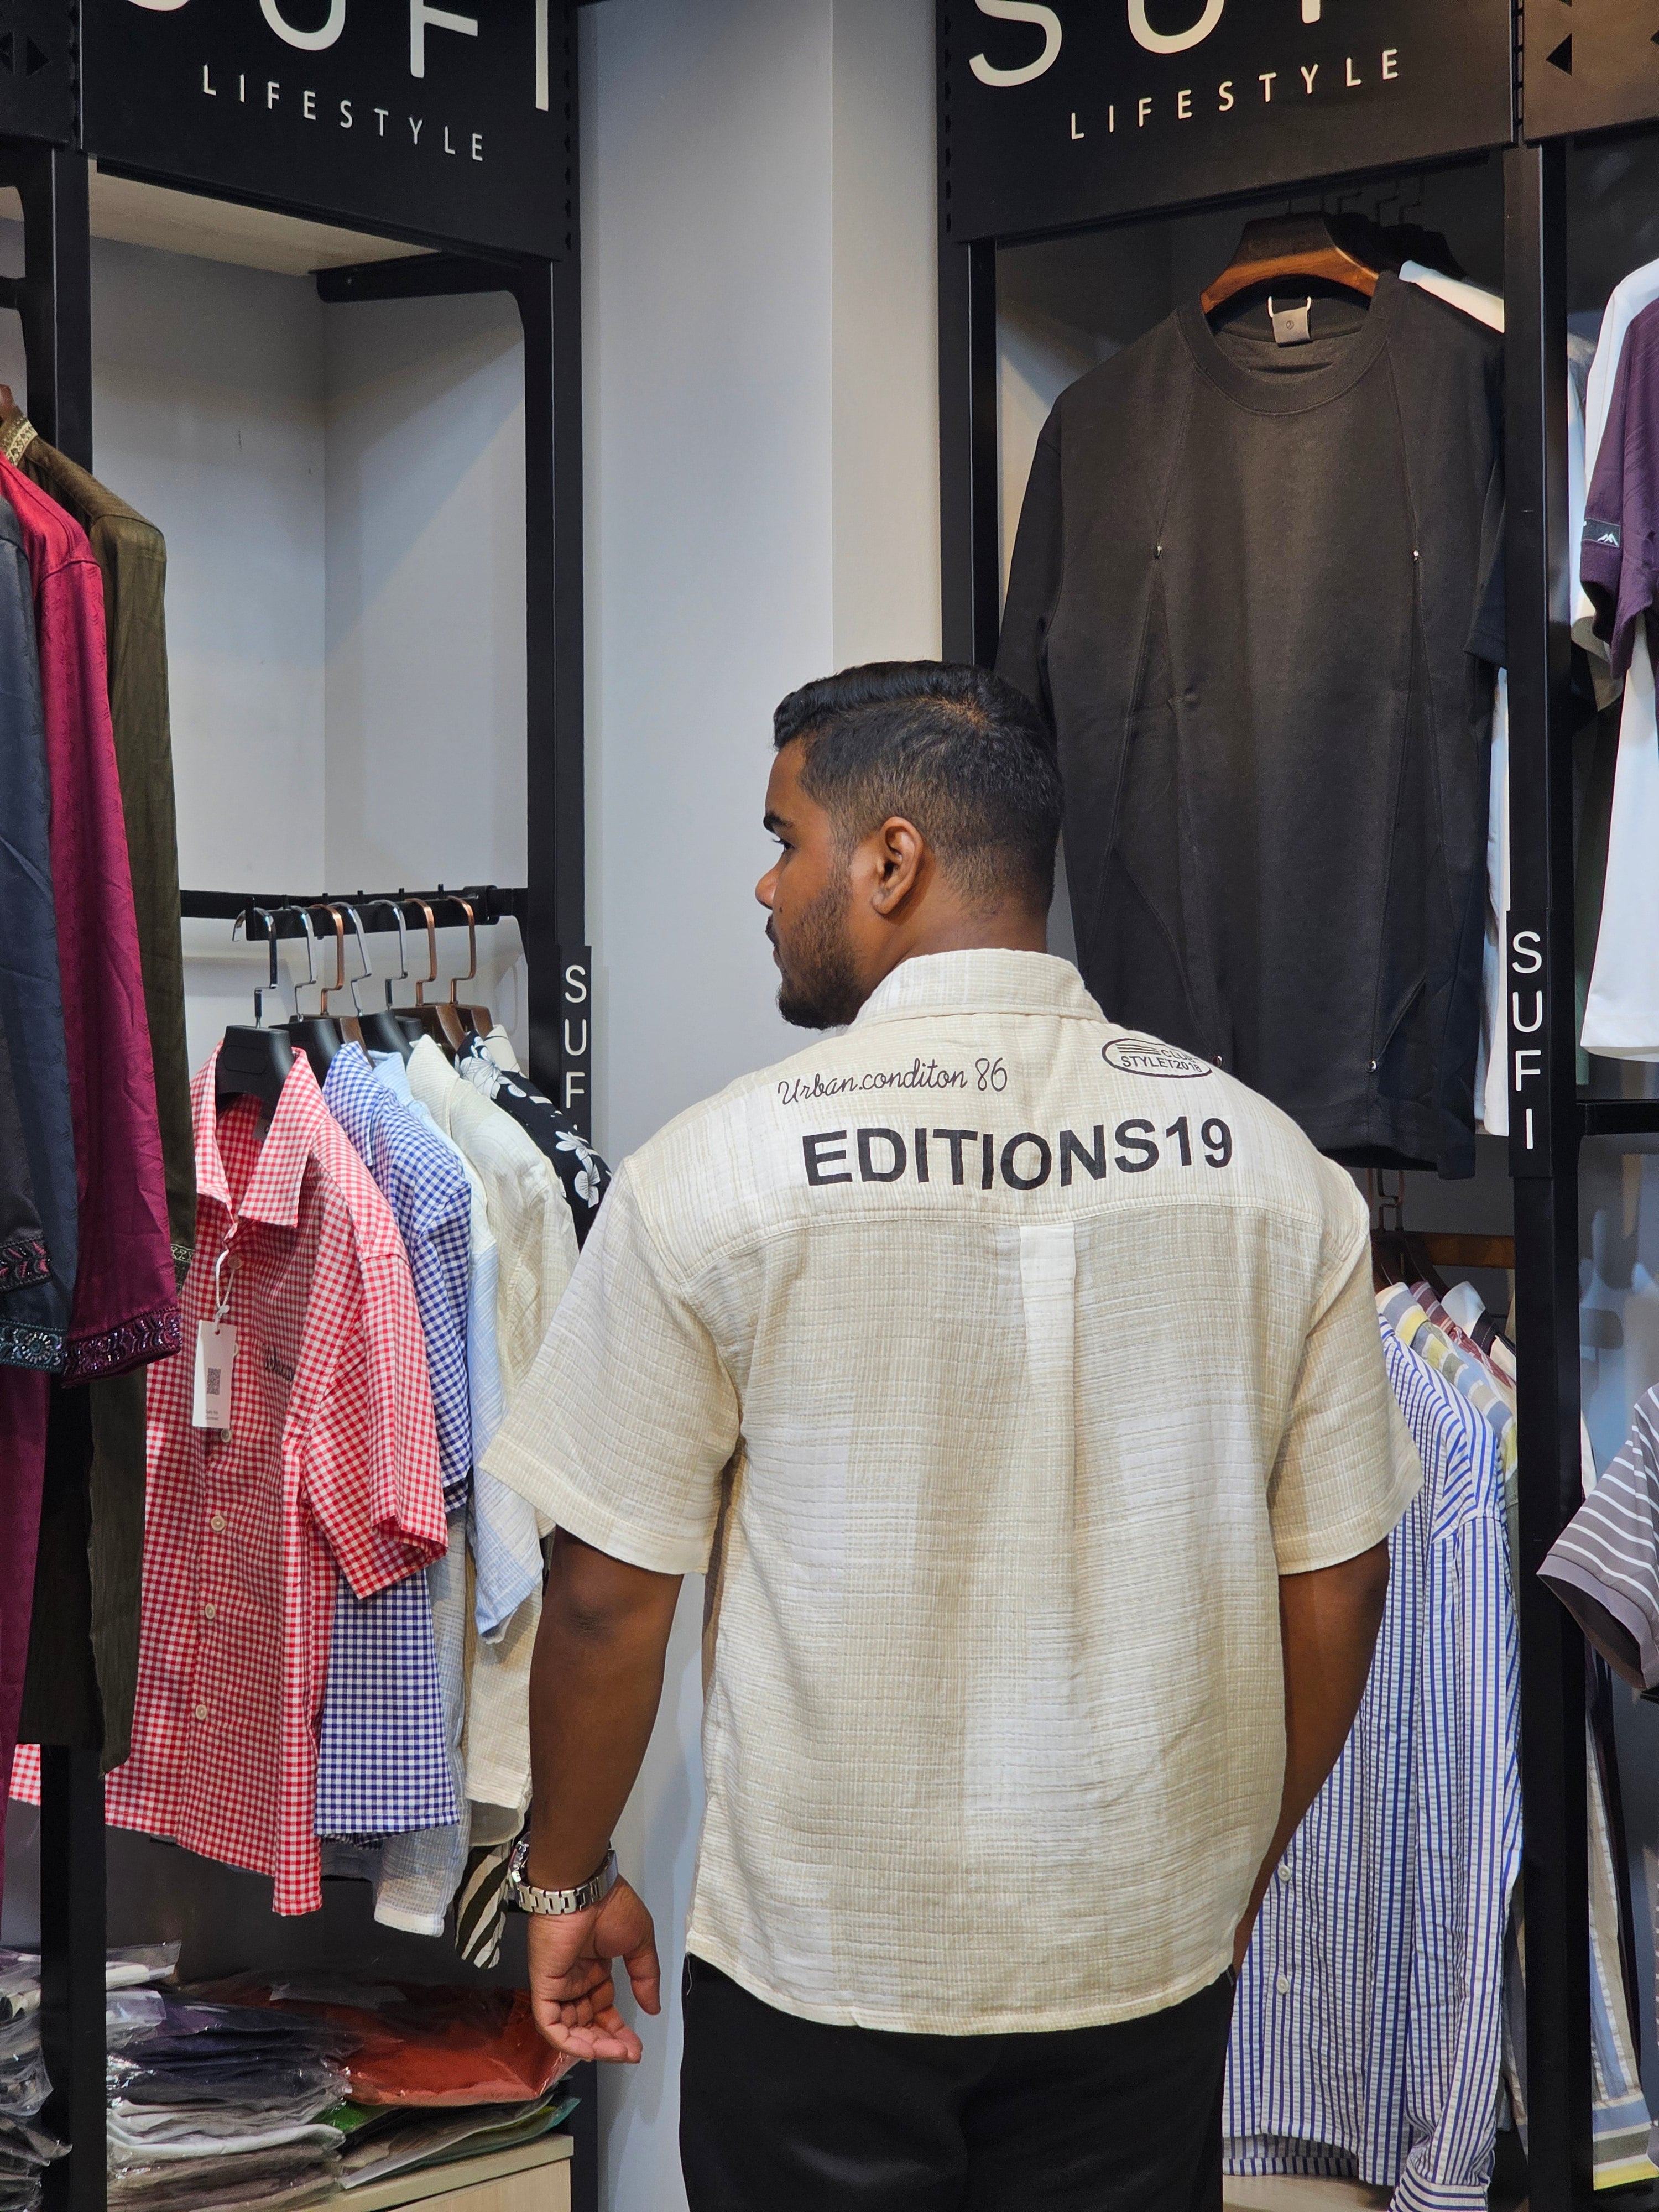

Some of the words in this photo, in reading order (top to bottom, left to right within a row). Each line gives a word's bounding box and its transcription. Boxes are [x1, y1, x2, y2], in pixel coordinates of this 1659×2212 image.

[202, 64, 483, 161] LIFESTYLE
[1071, 49, 1398, 140] LIFESTYLE
[565, 964, 587, 1131] SUF
[974, 1057, 1008, 1092] 86
[1120, 1055, 1203, 1073] STYLET2018
[1161, 1050, 1196, 1063] CLUB
[1512, 931, 1543, 1150] SUFI
[802, 1115, 1233, 1191] EDITIONS19
